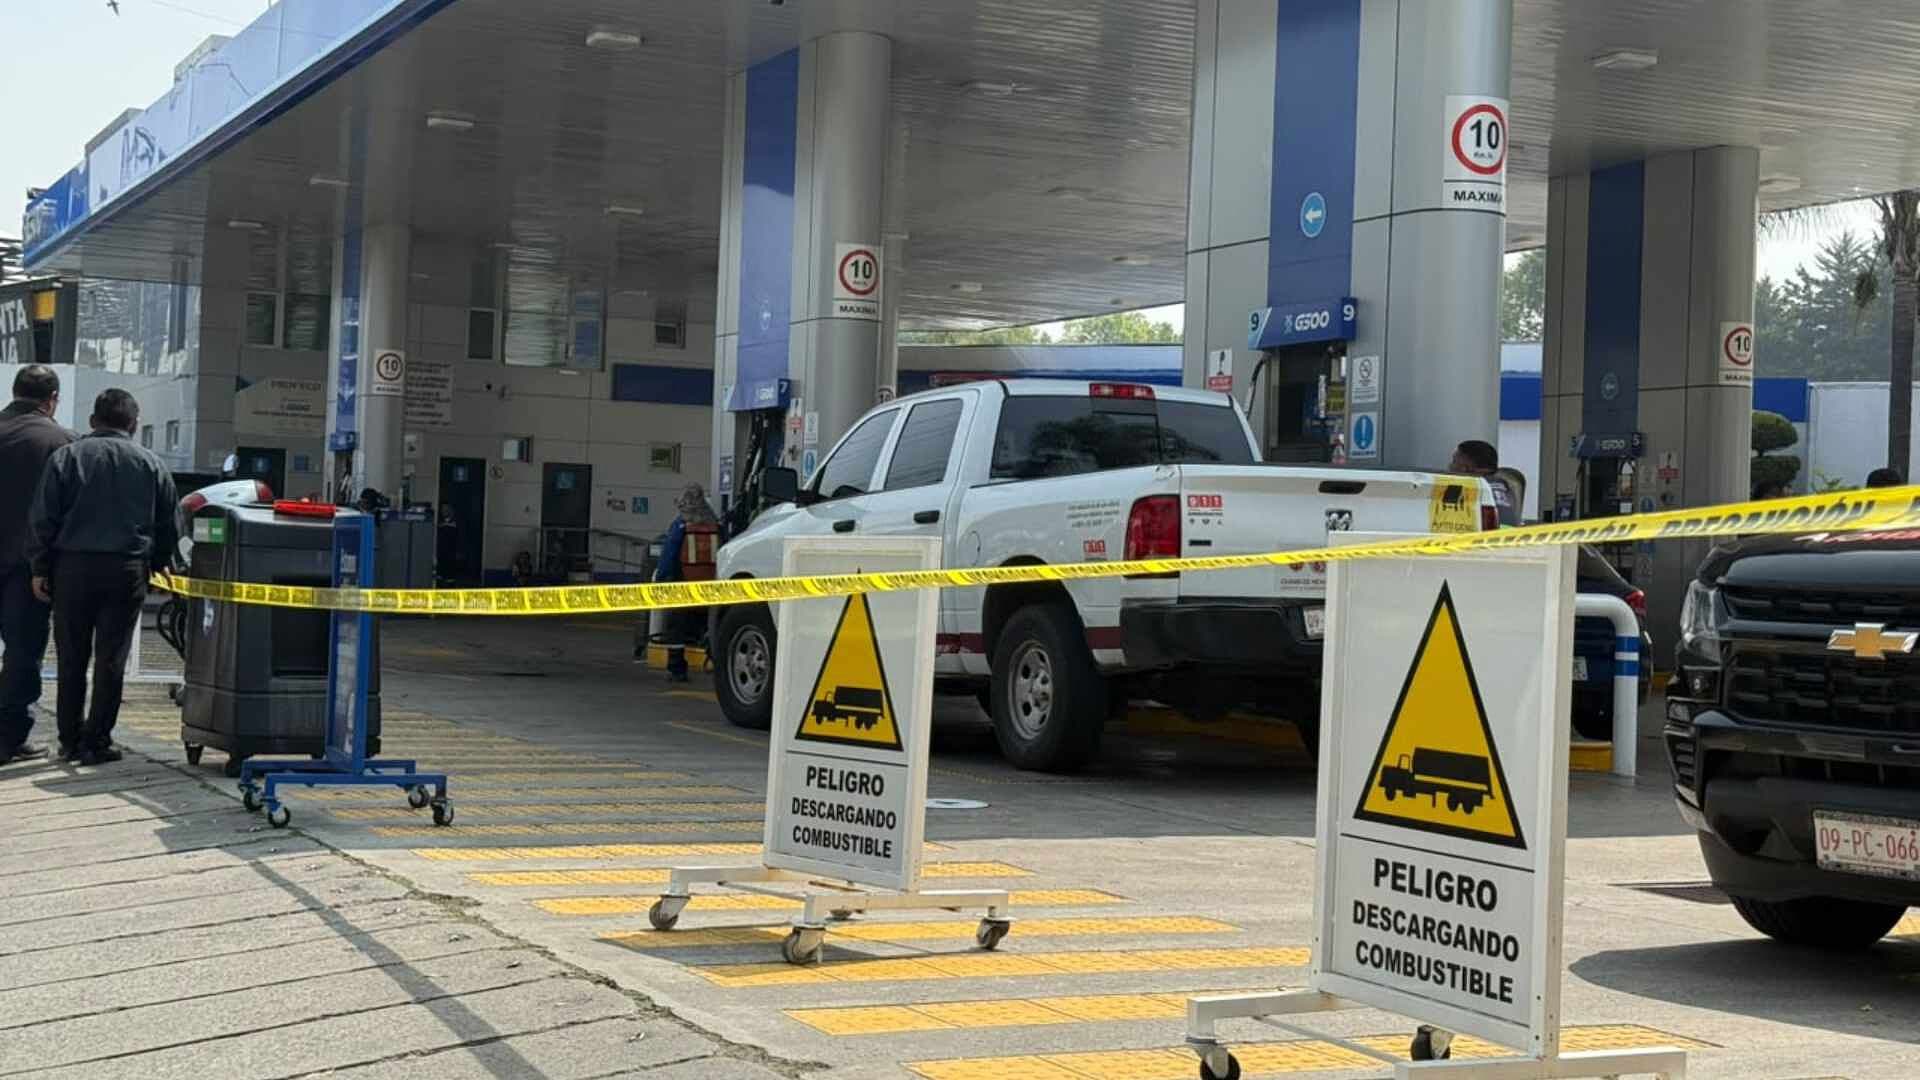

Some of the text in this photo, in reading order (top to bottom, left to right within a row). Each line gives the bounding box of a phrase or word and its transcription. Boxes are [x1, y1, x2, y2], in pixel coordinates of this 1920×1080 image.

[1470, 119, 1499, 150] 10
[850, 259, 873, 280] 10
[1250, 312, 1259, 331] 9
[1295, 311, 1330, 332] G500
[1343, 304, 1355, 322] 9
[1735, 335, 1751, 352] 10
[383, 359, 398, 372] 10
[779, 381, 789, 393] 7
[1632, 436, 1641, 446] 5
[806, 765, 885, 797] PELIGRO
[792, 796, 897, 830] DESCARGANDO
[792, 825, 893, 859] COMBUSTIBLE
[1374, 858, 1498, 912] PELIGRO
[1353, 900, 1519, 962] DESCARGANDO
[1355, 940, 1513, 1004] COMBUSTIBLE
